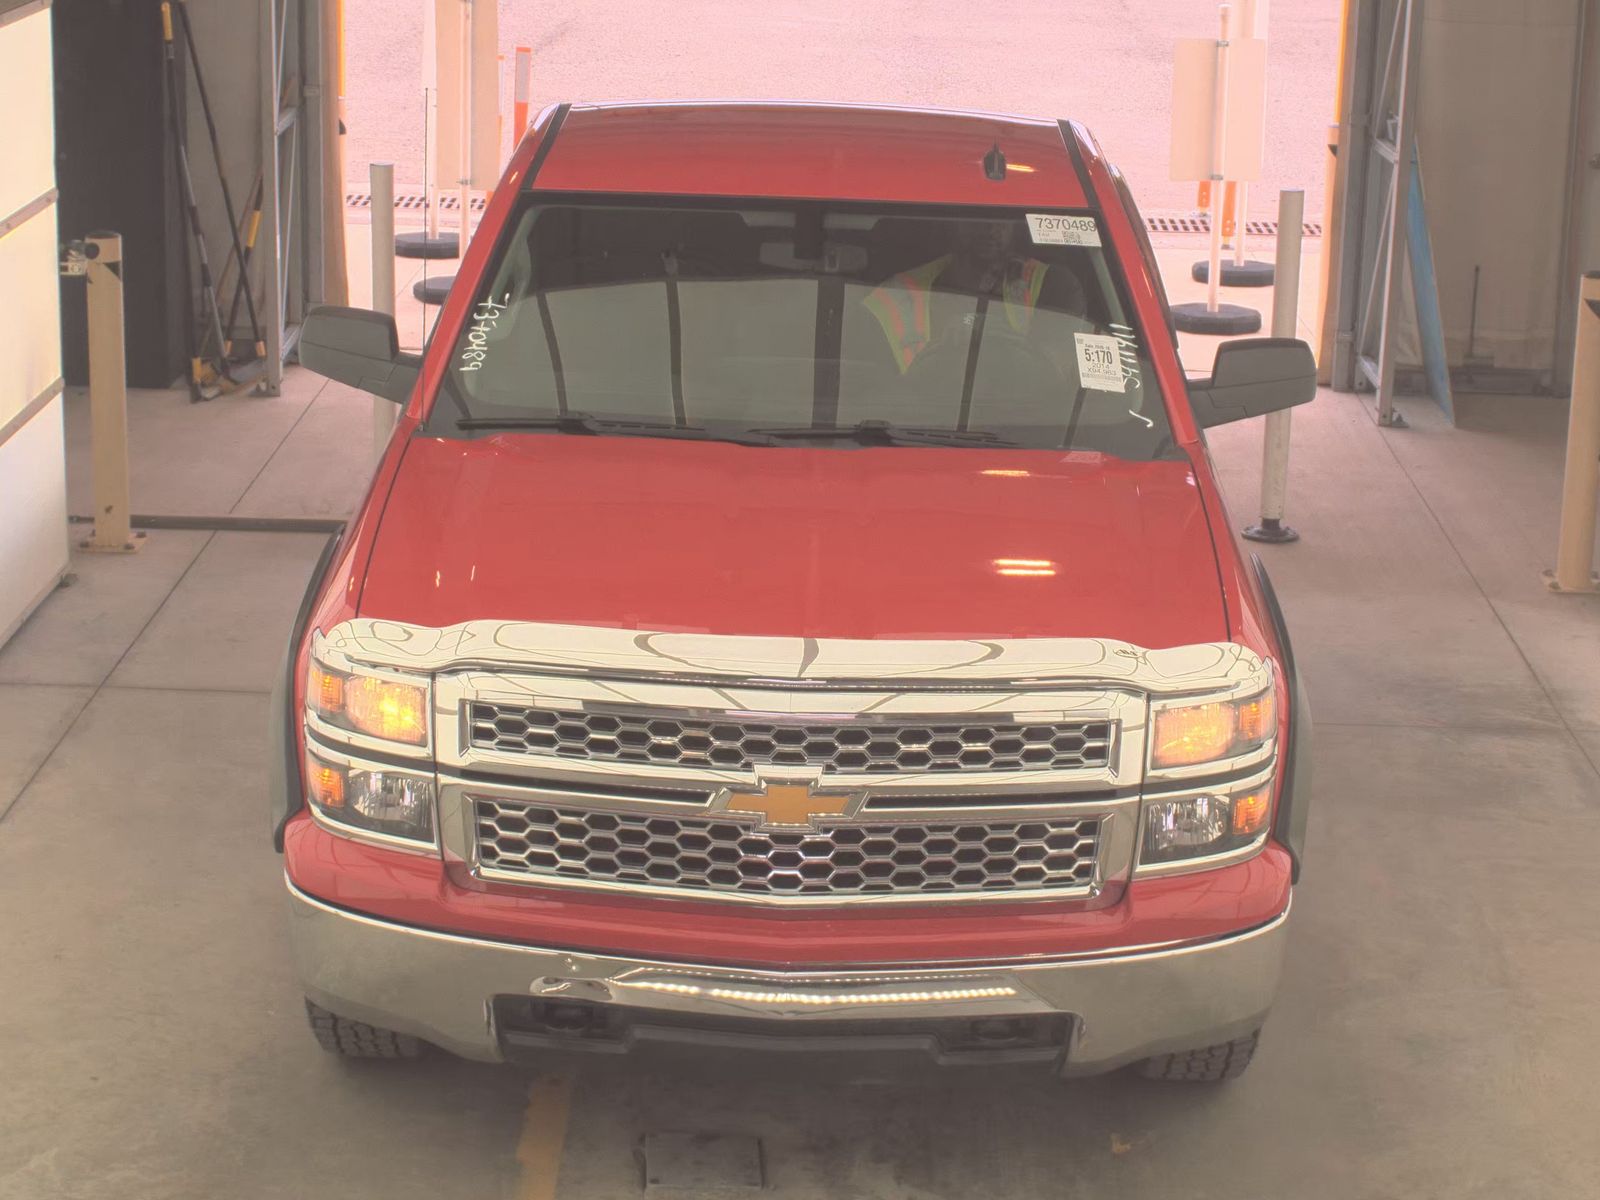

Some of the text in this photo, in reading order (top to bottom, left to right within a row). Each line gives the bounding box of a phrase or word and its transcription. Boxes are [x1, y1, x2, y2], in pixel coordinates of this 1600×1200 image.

[1035, 217, 1097, 232] 7370489
[1084, 348, 1113, 365] 5:170
[1092, 362, 1110, 370] 2014
